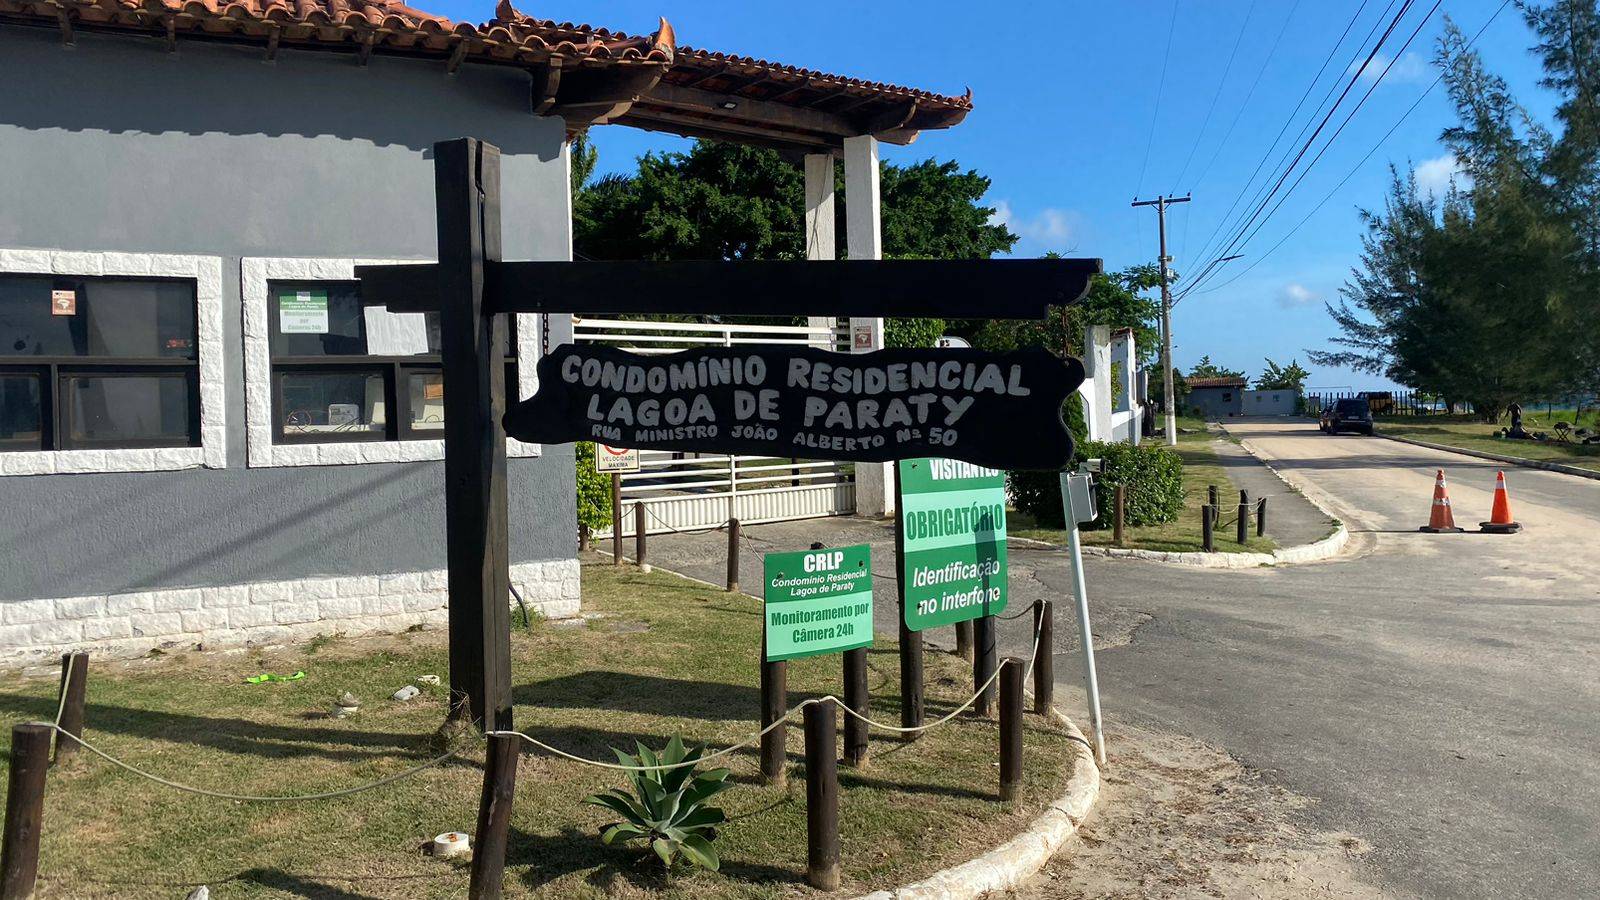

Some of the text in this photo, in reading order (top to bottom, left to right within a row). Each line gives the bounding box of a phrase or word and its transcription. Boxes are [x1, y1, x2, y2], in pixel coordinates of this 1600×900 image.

[561, 355, 1031, 396] CONDOMÍNIO RESIDENCIAL
[587, 389, 975, 430] LAGOA DE PARATY
[592, 424, 621, 440] RUA
[635, 425, 718, 442] MINISTRO
[731, 423, 778, 441] JOÃO
[792, 432, 885, 451] ALBERTO
[929, 427, 958, 447] 50
[906, 501, 1003, 540] OBRIGATÓRIO
[803, 551, 844, 573] CRLP
[912, 557, 1000, 588] Identificação
[771, 568, 868, 588] Condomínio Residencial
[790, 581, 855, 598] Lagoa de Paraty
[771, 603, 870, 626] Monitoramento por
[918, 586, 1001, 616] no interfone
[792, 622, 854, 643] Câmera 24h
